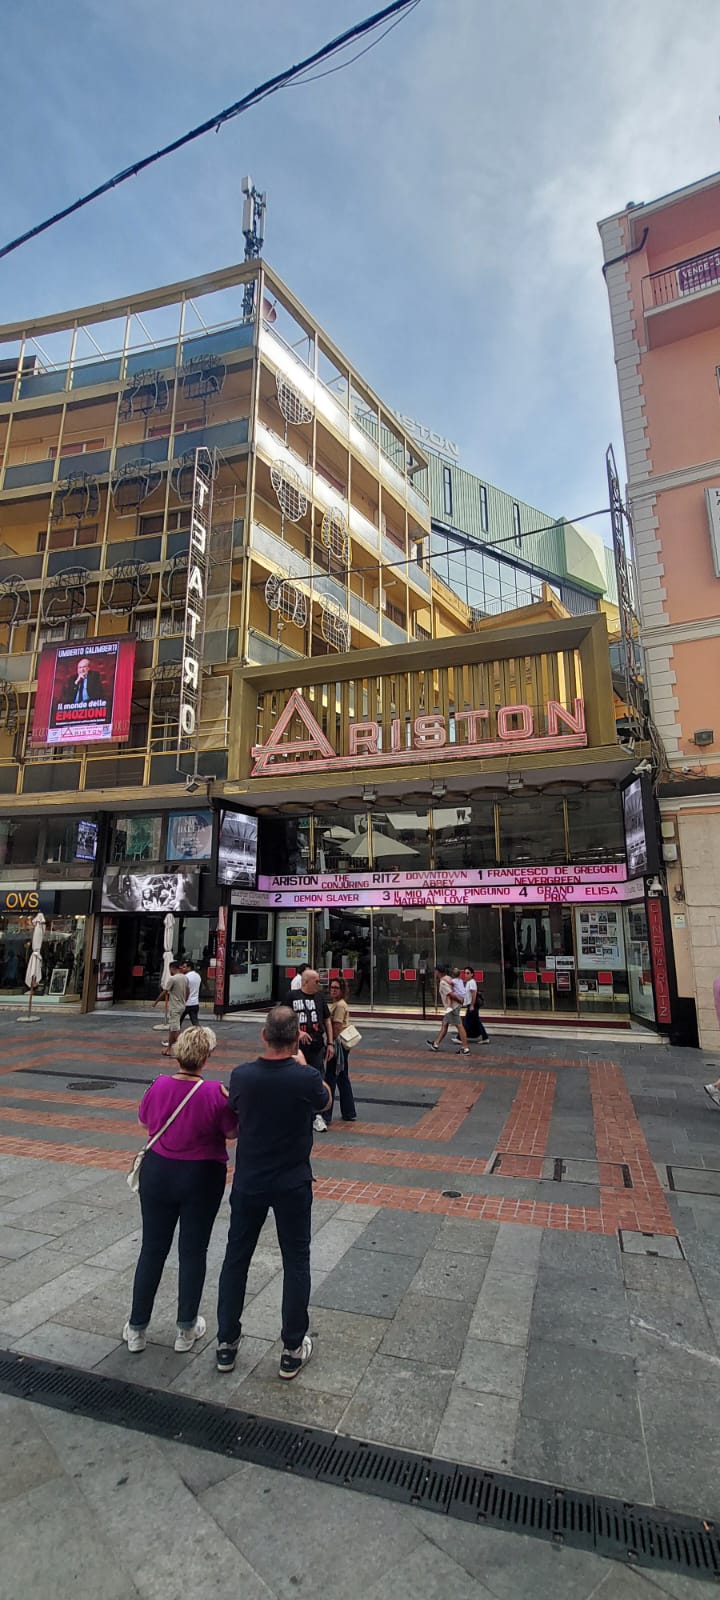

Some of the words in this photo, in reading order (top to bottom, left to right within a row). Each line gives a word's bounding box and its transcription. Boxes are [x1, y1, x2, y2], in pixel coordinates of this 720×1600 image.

[64, 701, 87, 710] mondo
[88, 699, 107, 708] delle
[55, 708, 107, 721] EMOZIONI
[251, 689, 587, 768] ARISTON
[478, 870, 483, 880] 1
[487, 867, 548, 877] FRANCESCO
[554, 866, 569, 875] DE
[574, 865, 618, 874] GREGORI
[271, 875, 319, 886] ARISTON
[334, 874, 349, 882] THE
[372, 873, 400, 884] RITZ
[514, 875, 582, 885] NEVERGREEN
[321, 880, 370, 889] CONJURING
[422, 879, 455, 888] ABBEY
[382, 890, 391, 901] 3
[405, 889, 422, 898] MIO
[427, 888, 457, 897] AMICO
[464, 887, 510, 896] PINGUINO
[518, 886, 528, 898] 4
[537, 886, 575, 895] GRAND
[585, 886, 618, 895] ELISA
[5, 892, 40, 909] OVS
[274, 894, 283, 903] 2
[294, 894, 323, 903] DEMON
[326, 893, 359, 902] SLAYER
[394, 896, 436, 905] MATERIAL
[444, 896, 469, 904] LOVE
[544, 893, 567, 902] PRIX
